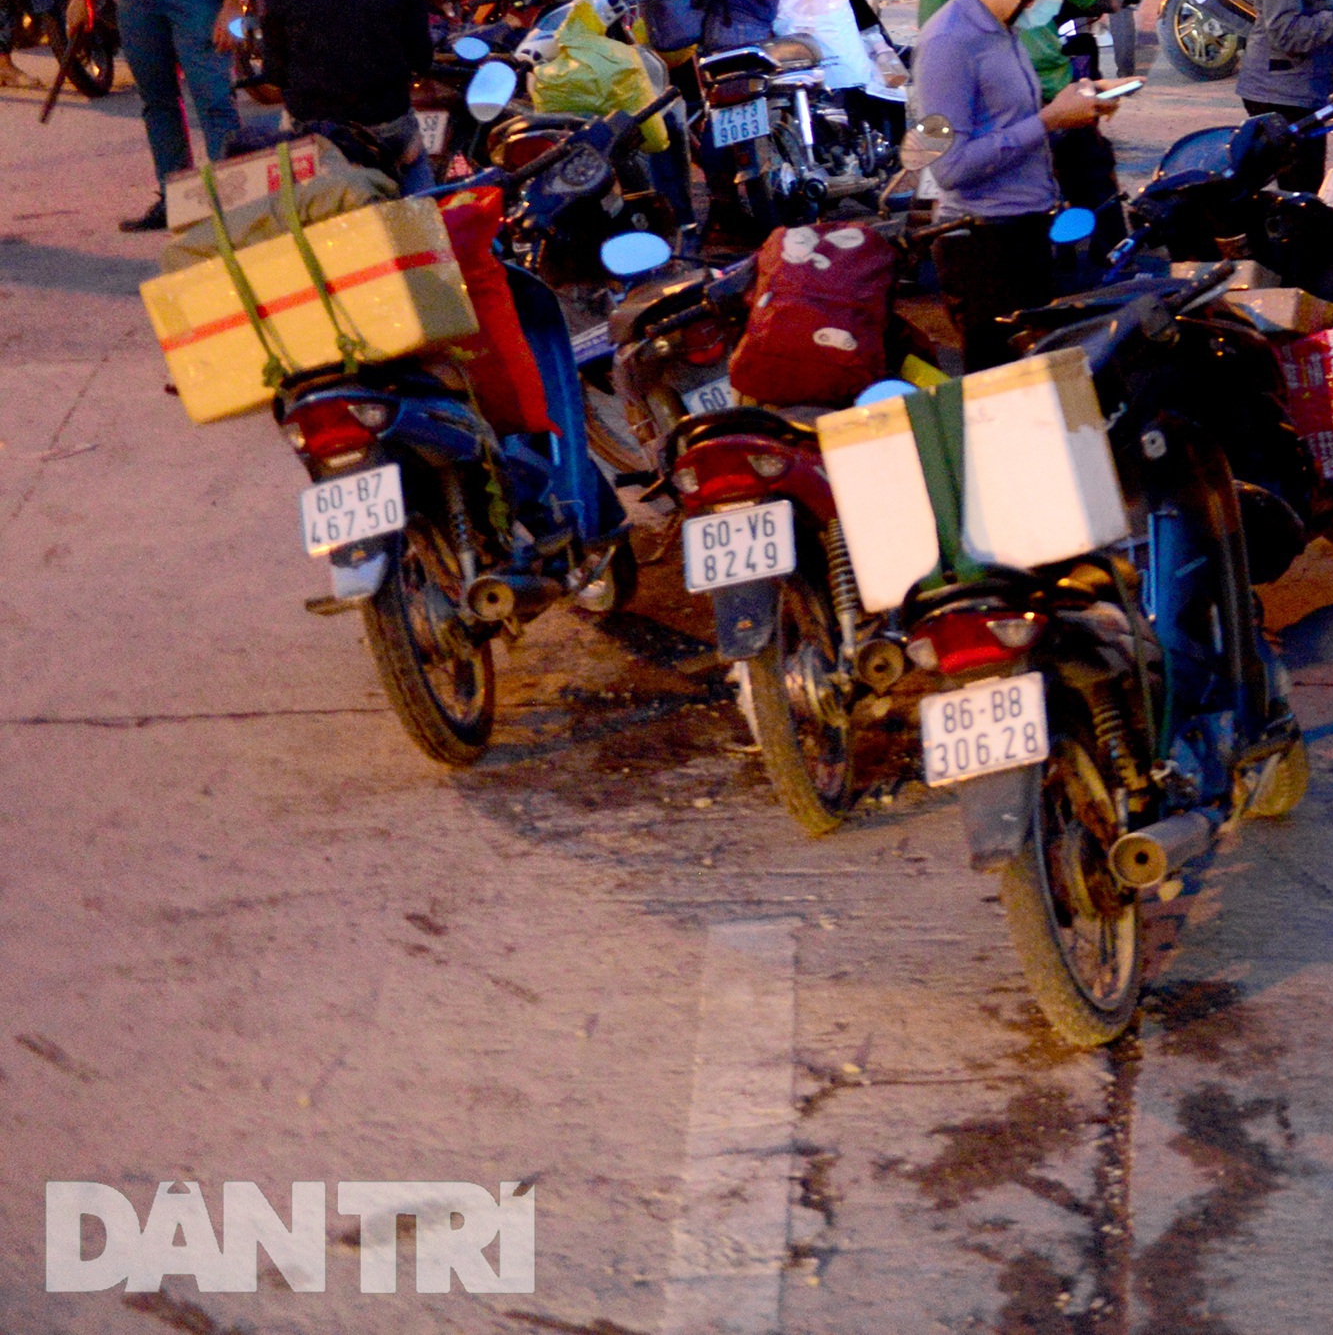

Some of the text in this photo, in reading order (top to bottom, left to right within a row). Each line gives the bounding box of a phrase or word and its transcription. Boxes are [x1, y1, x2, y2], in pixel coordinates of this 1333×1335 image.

[720, 119, 760, 143] 9063
[316, 472, 383, 513] 60-B7
[311, 498, 398, 543] 467.50
[702, 511, 775, 550] 60-V6
[704, 541, 778, 582] 8249
[942, 686, 1022, 734] 86-B8
[935, 722, 1038, 777] 306.28
